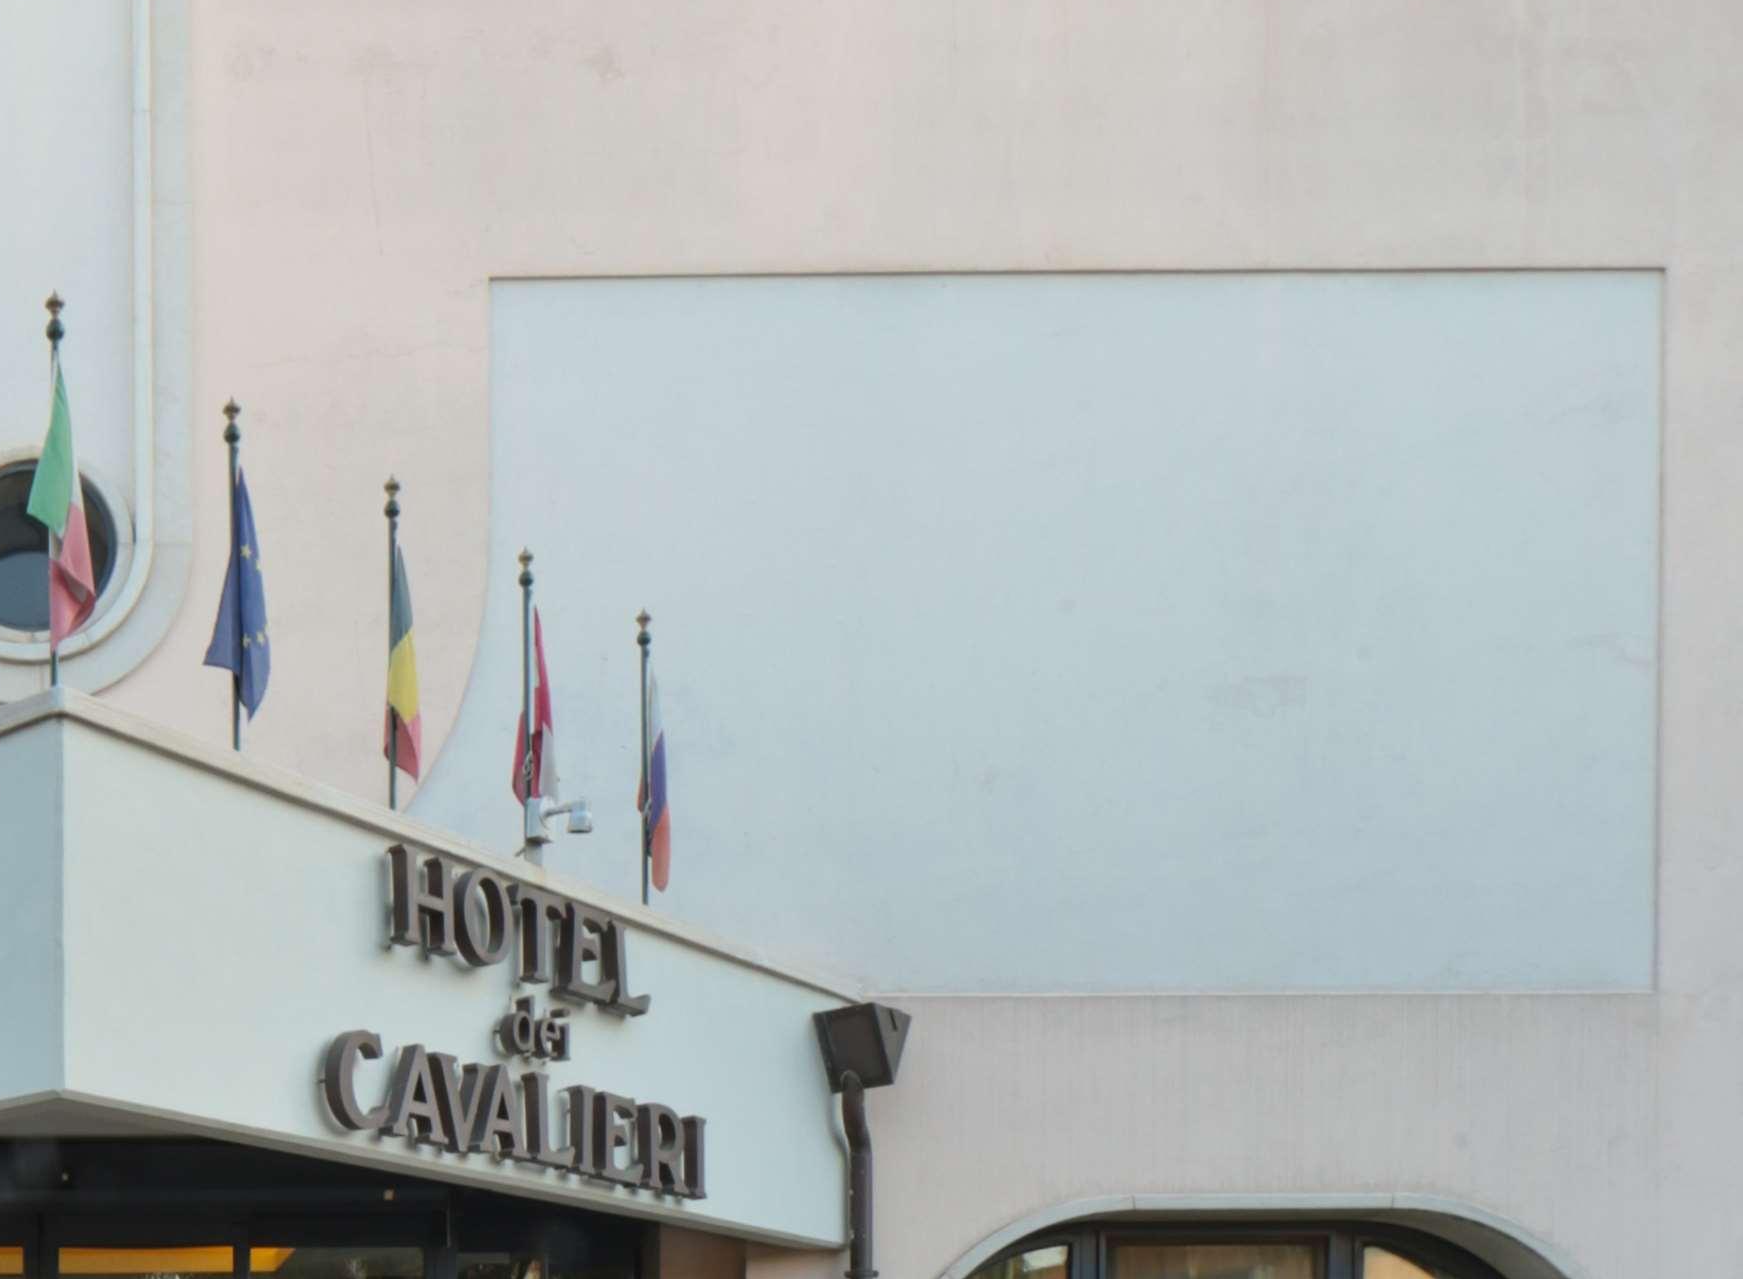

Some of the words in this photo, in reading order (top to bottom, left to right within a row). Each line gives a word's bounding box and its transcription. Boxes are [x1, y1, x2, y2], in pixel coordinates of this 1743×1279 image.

[385, 843, 652, 1018] HOTEL
[497, 994, 571, 1062] dei
[322, 1029, 707, 1201] CAVALIERI
